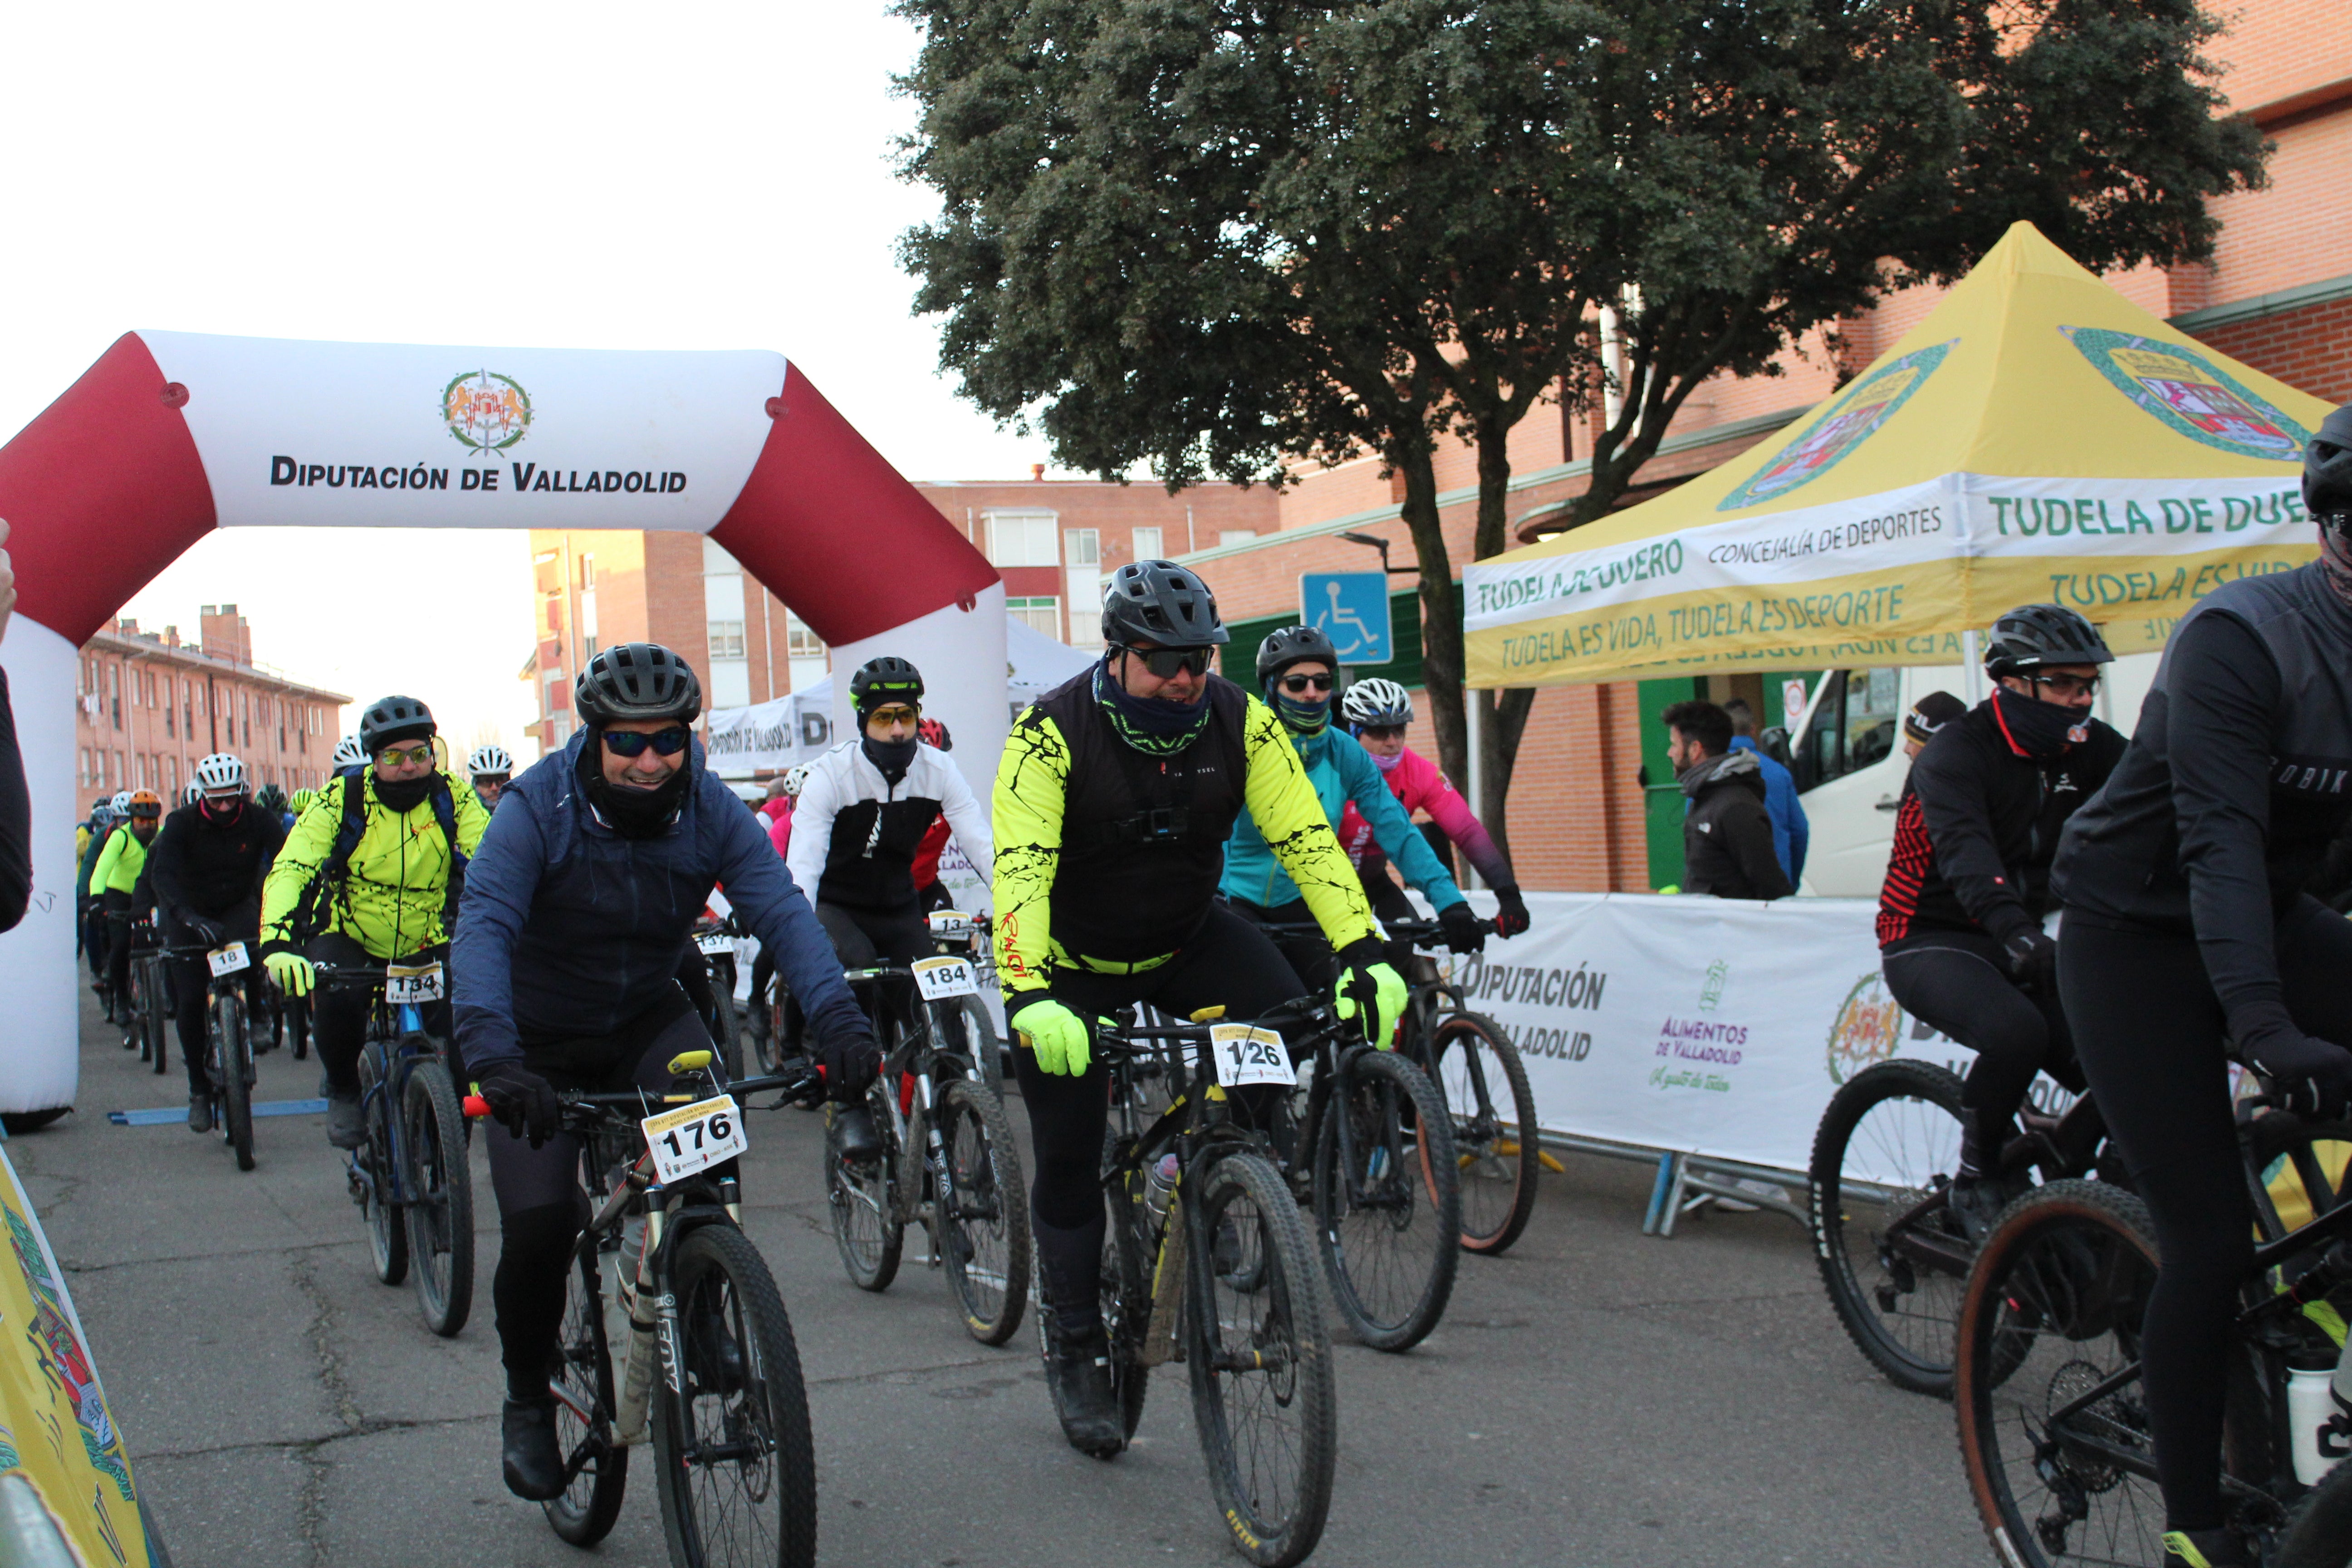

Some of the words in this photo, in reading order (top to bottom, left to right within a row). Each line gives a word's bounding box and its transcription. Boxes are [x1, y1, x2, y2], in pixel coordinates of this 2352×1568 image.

[270, 456, 449, 490] DIPUTACIÓN
[460, 469, 499, 491] DE
[512, 462, 687, 493] VALLADOLID
[1709, 529, 1813, 564] CONCEJALÍA
[1818, 526, 1842, 553] DE
[1847, 506, 1942, 548] DEPORTES
[1988, 496, 2153, 536] TUDELA
[2158, 497, 2215, 534] DE
[2050, 567, 2186, 605] TUDELA
[1502, 629, 1577, 669] TUDELA
[1579, 622, 1603, 656] ES
[1608, 613, 1663, 651] VIDA,
[1669, 600, 1753, 642] TUDELA
[1759, 598, 1788, 632] ES
[1786, 584, 1905, 630] DEPORTE
[925, 965, 966, 985] 184
[1461, 952, 1607, 1011] DIPUTACIÓN
[1660, 1015, 1748, 1045] ALIMENTOS
[1226, 1041, 1281, 1067] 126
[663, 1113, 731, 1157] 176
